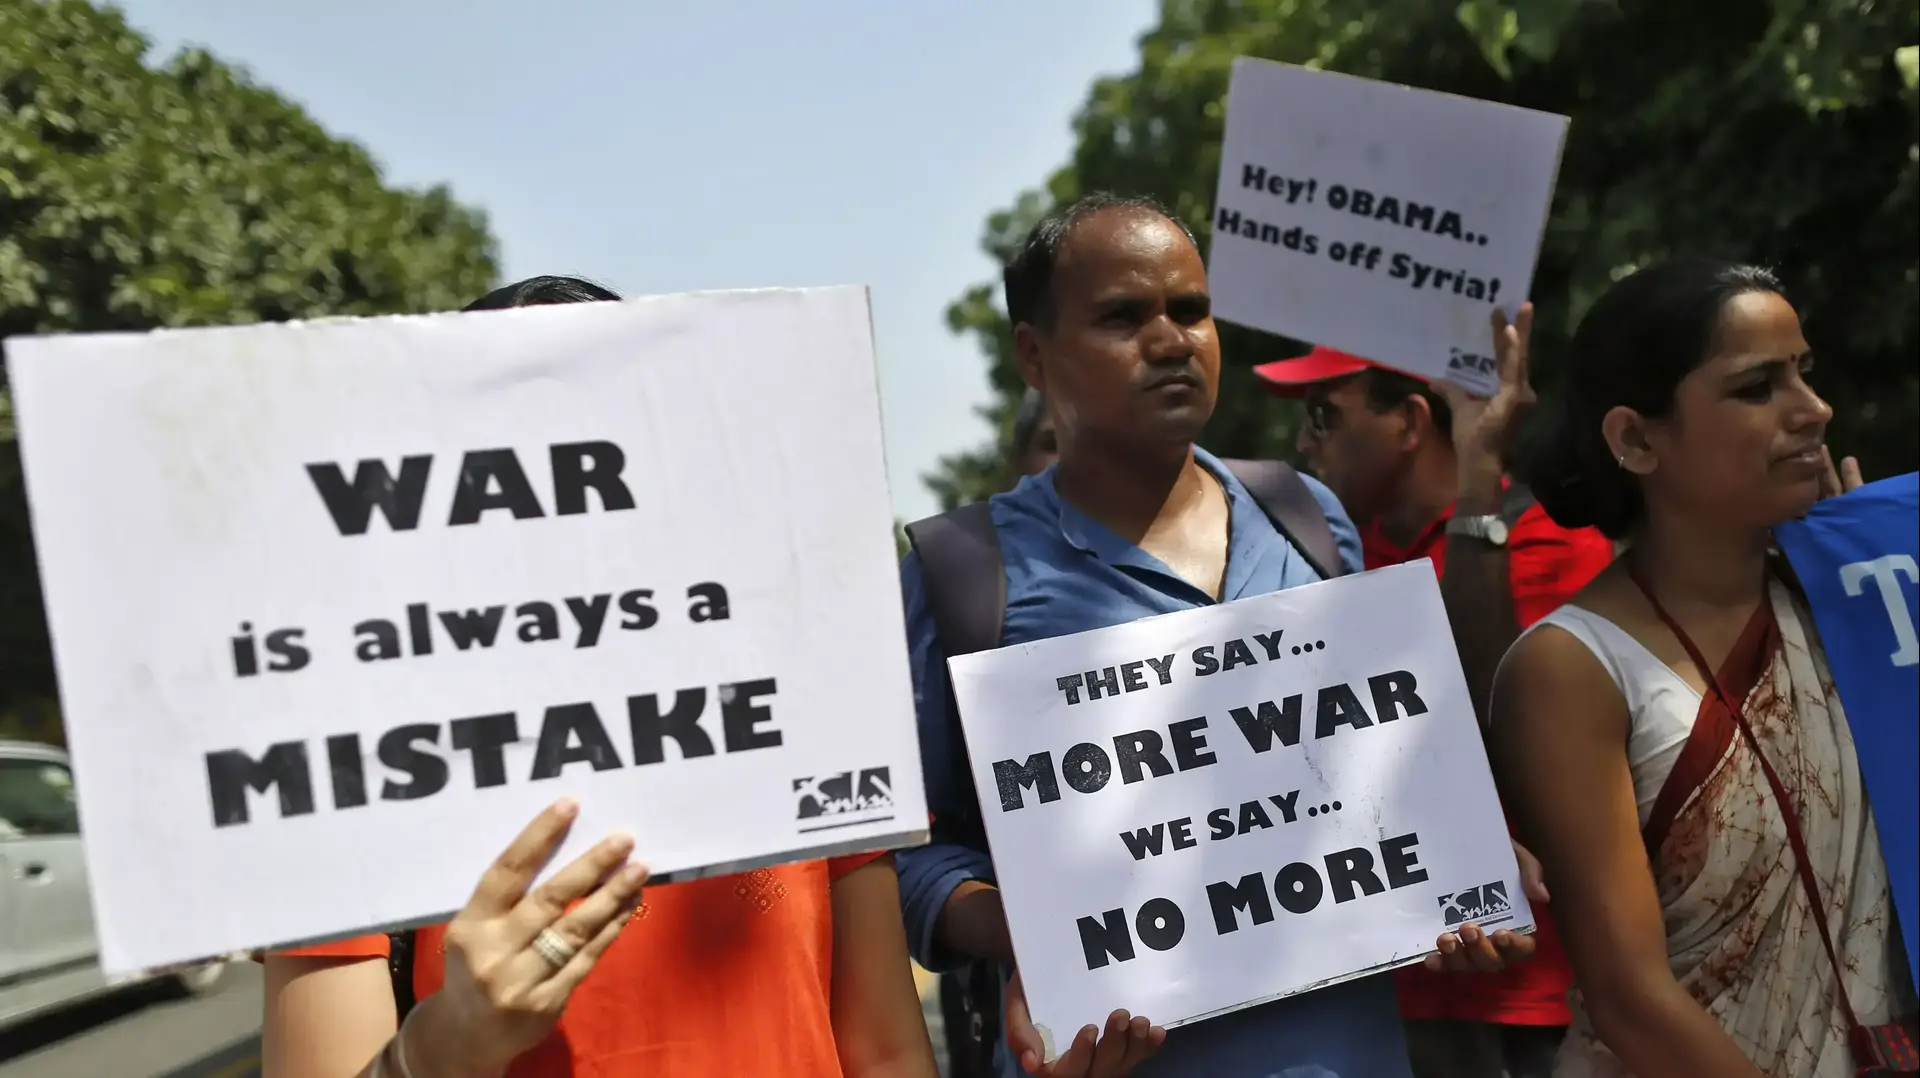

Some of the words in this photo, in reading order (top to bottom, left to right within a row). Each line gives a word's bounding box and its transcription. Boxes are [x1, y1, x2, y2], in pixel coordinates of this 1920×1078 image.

[1241, 163, 1318, 205] Hey!
[1218, 207, 1320, 256] Hands
[1327, 240, 1383, 271] off
[1388, 251, 1502, 305] Syria!
[304, 440, 637, 537] WAR
[232, 618, 310, 677] is
[353, 588, 660, 663] always
[687, 582, 731, 623] a
[1055, 652, 1176, 707] THEY
[1191, 628, 1327, 678] SAY...
[204, 677, 784, 828] MISTAKE
[992, 714, 1218, 812] MORE
[1227, 669, 1430, 755] WAR
[1117, 815, 1199, 862] WE
[1206, 788, 1343, 842] SAY...
[1076, 896, 1187, 972] NO
[1205, 831, 1431, 937] MORE
